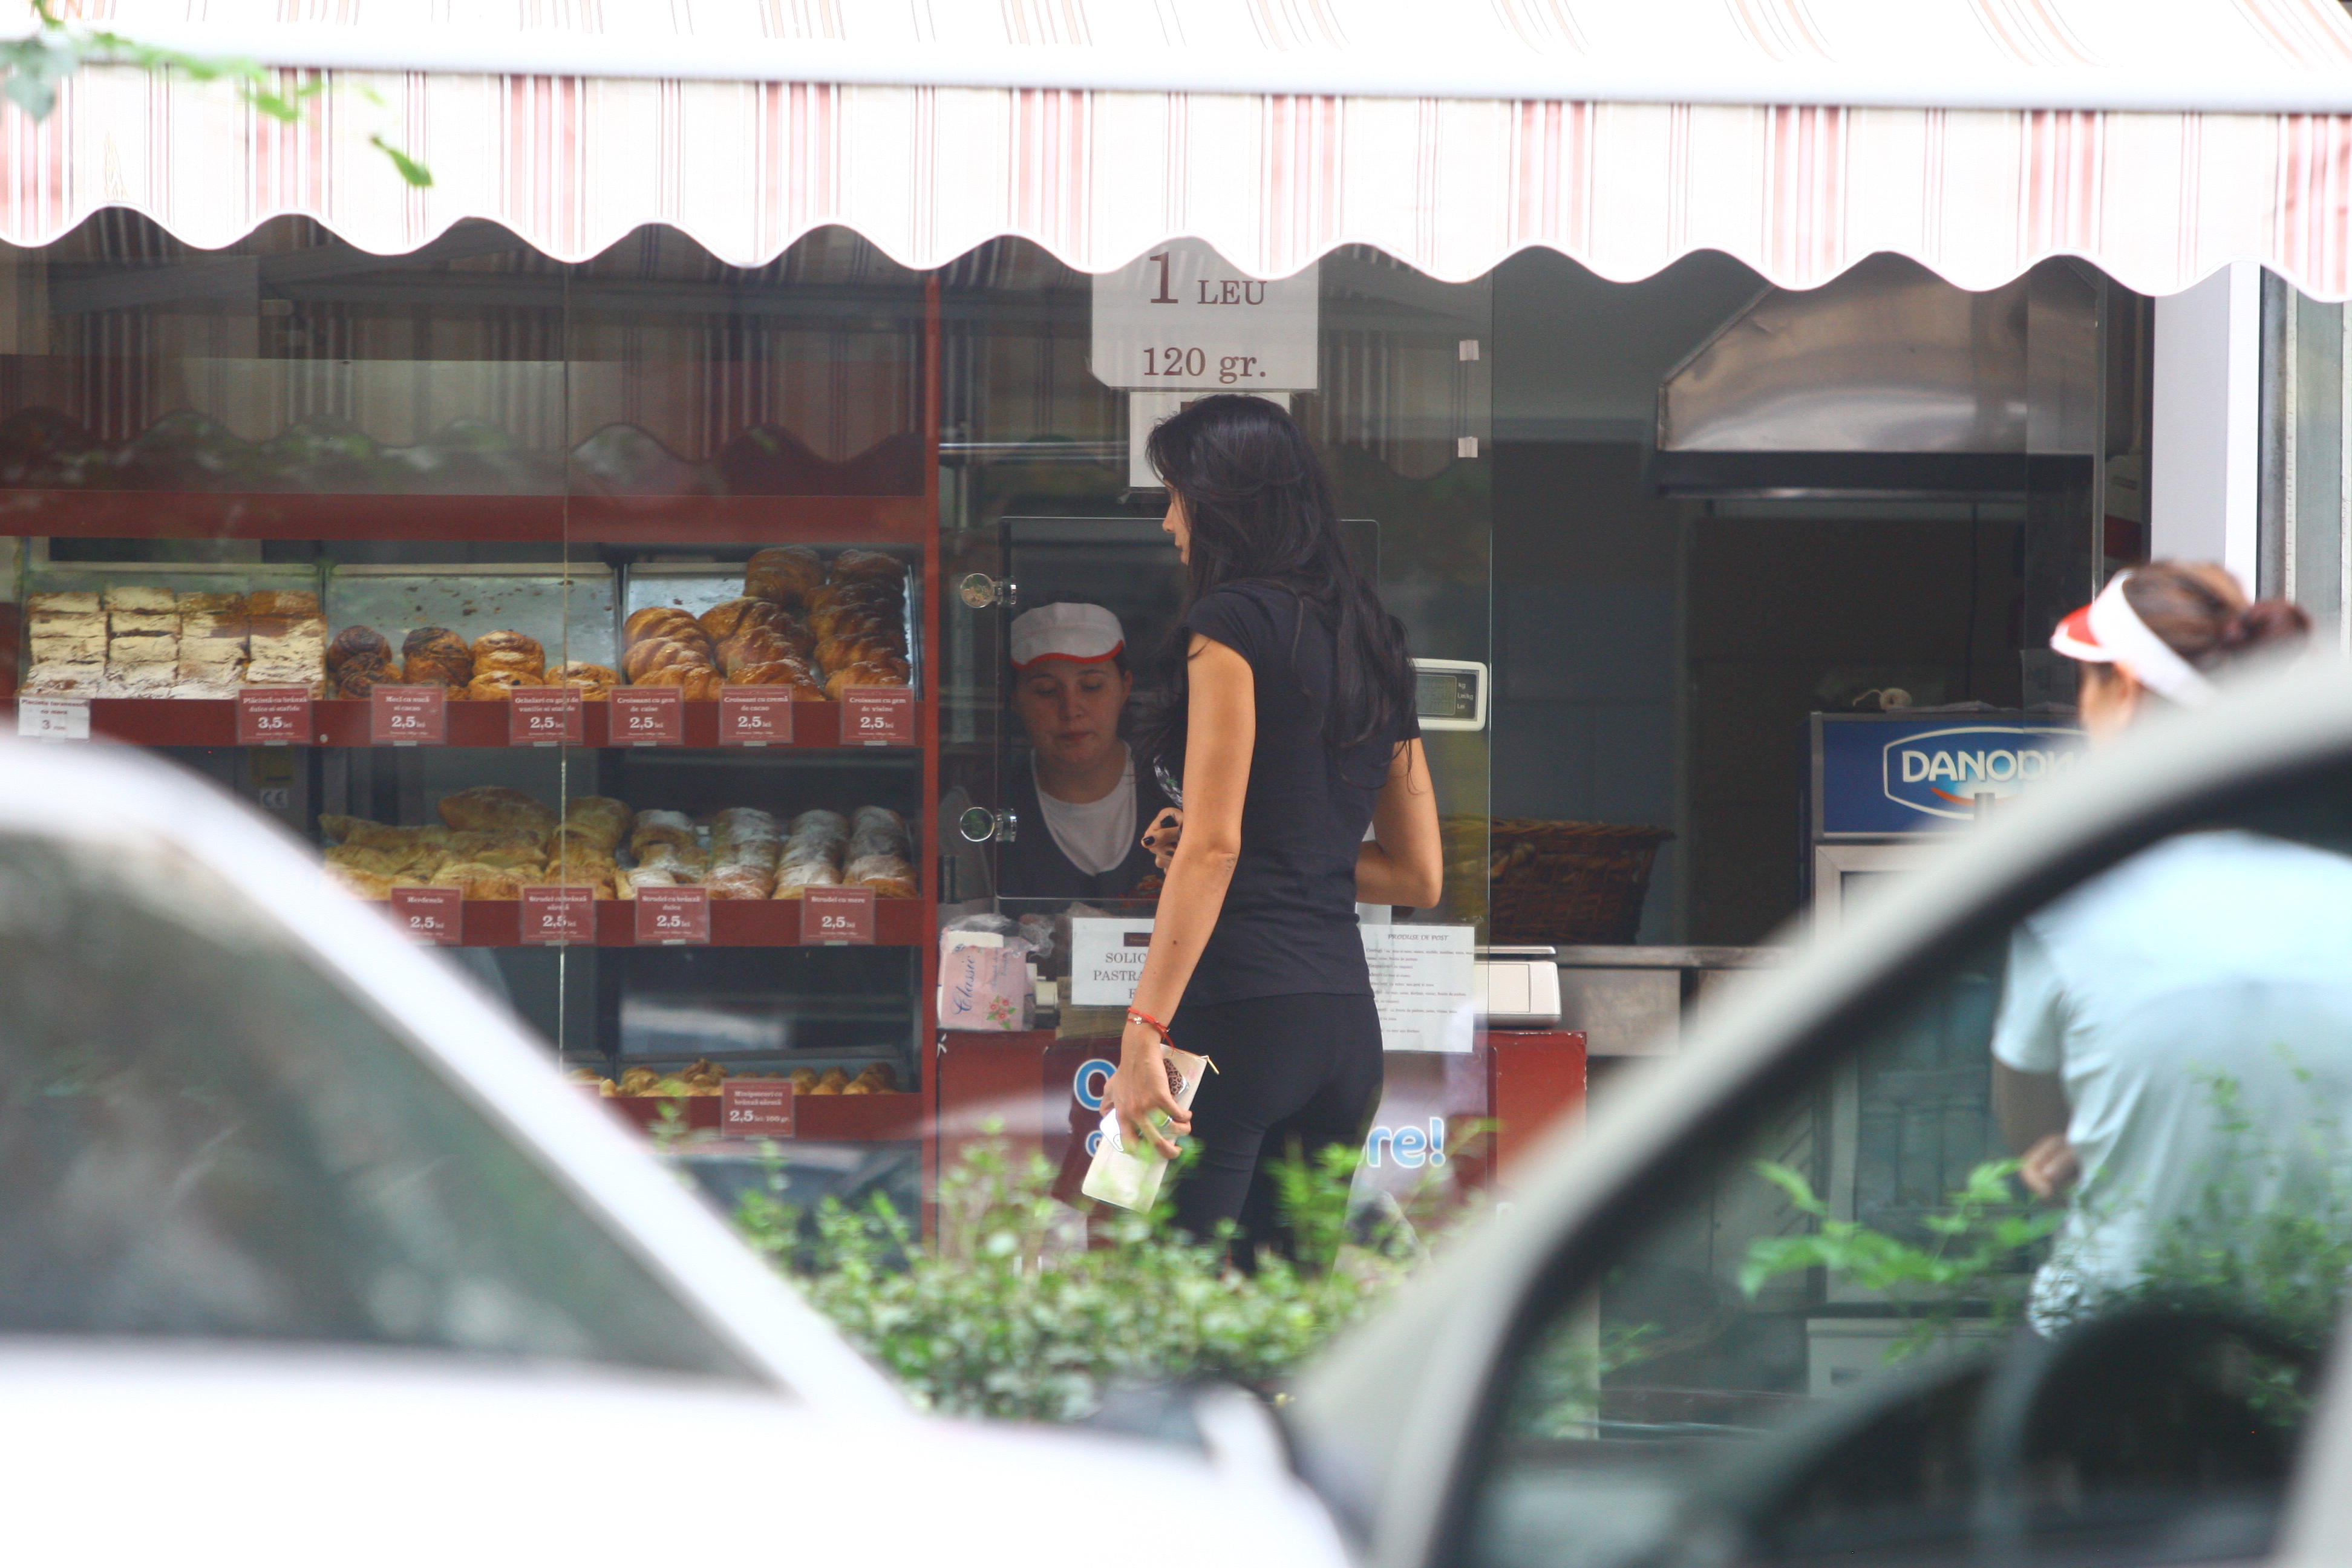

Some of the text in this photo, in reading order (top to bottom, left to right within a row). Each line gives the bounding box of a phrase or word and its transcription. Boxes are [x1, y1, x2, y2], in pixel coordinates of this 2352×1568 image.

[1149, 251, 1268, 305] 1 LEU
[1143, 347, 1267, 384] 120 gr.
[42, 719, 50, 730] 3
[258, 716, 283, 730] 3,5
[391, 716, 416, 730] 2,5
[530, 716, 555, 731] 2,5
[630, 716, 653, 730] 2,5
[737, 716, 762, 729] 2,5
[860, 717, 884, 730] 2,5
[410, 916, 434, 930] 2,5
[543, 915, 567, 929] 2,5
[656, 915, 681, 929] 2,5
[822, 915, 846, 929] 2,5
[1093, 970, 1143, 981] PASTR
[730, 1109, 754, 1123] 2,5
